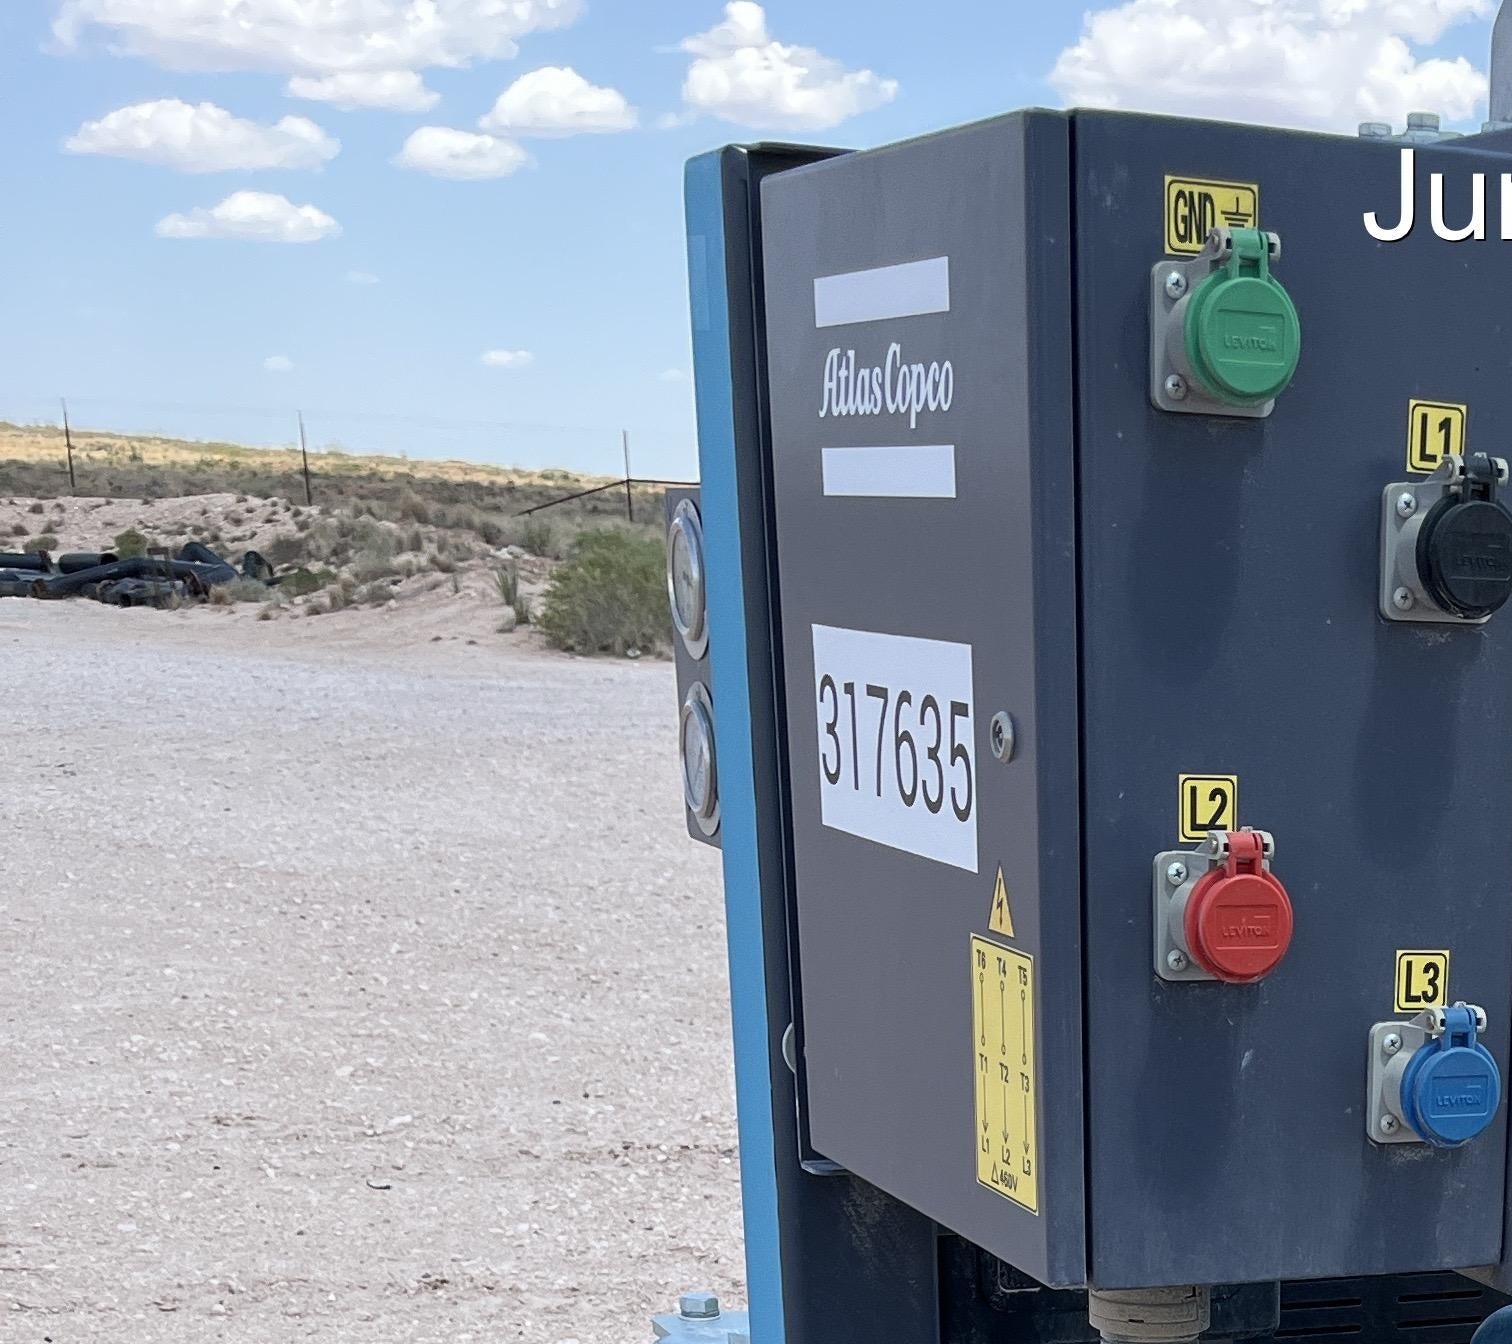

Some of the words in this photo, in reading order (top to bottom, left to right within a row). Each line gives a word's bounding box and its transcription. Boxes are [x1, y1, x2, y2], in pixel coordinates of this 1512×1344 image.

[1173, 188, 1216, 245] GND
[818, 347, 883, 418] Atlas
[884, 341, 954, 429] Copco
[1419, 412, 1452, 464] L1
[819, 673, 973, 823] 317635
[1189, 785, 1228, 832] L2
[976, 948, 986, 970] T6
[996, 956, 1007, 978] T4
[1017, 965, 1028, 987] T5
[1404, 959, 1440, 1004] L3
[978, 1052, 988, 1074] T1
[998, 1061, 1009, 1084] T2
[1019, 1071, 1030, 1093] T3
[981, 1135, 990, 1155] L1
[1001, 1144, 1011, 1166] L2
[1022, 1155, 1032, 1177] L3
